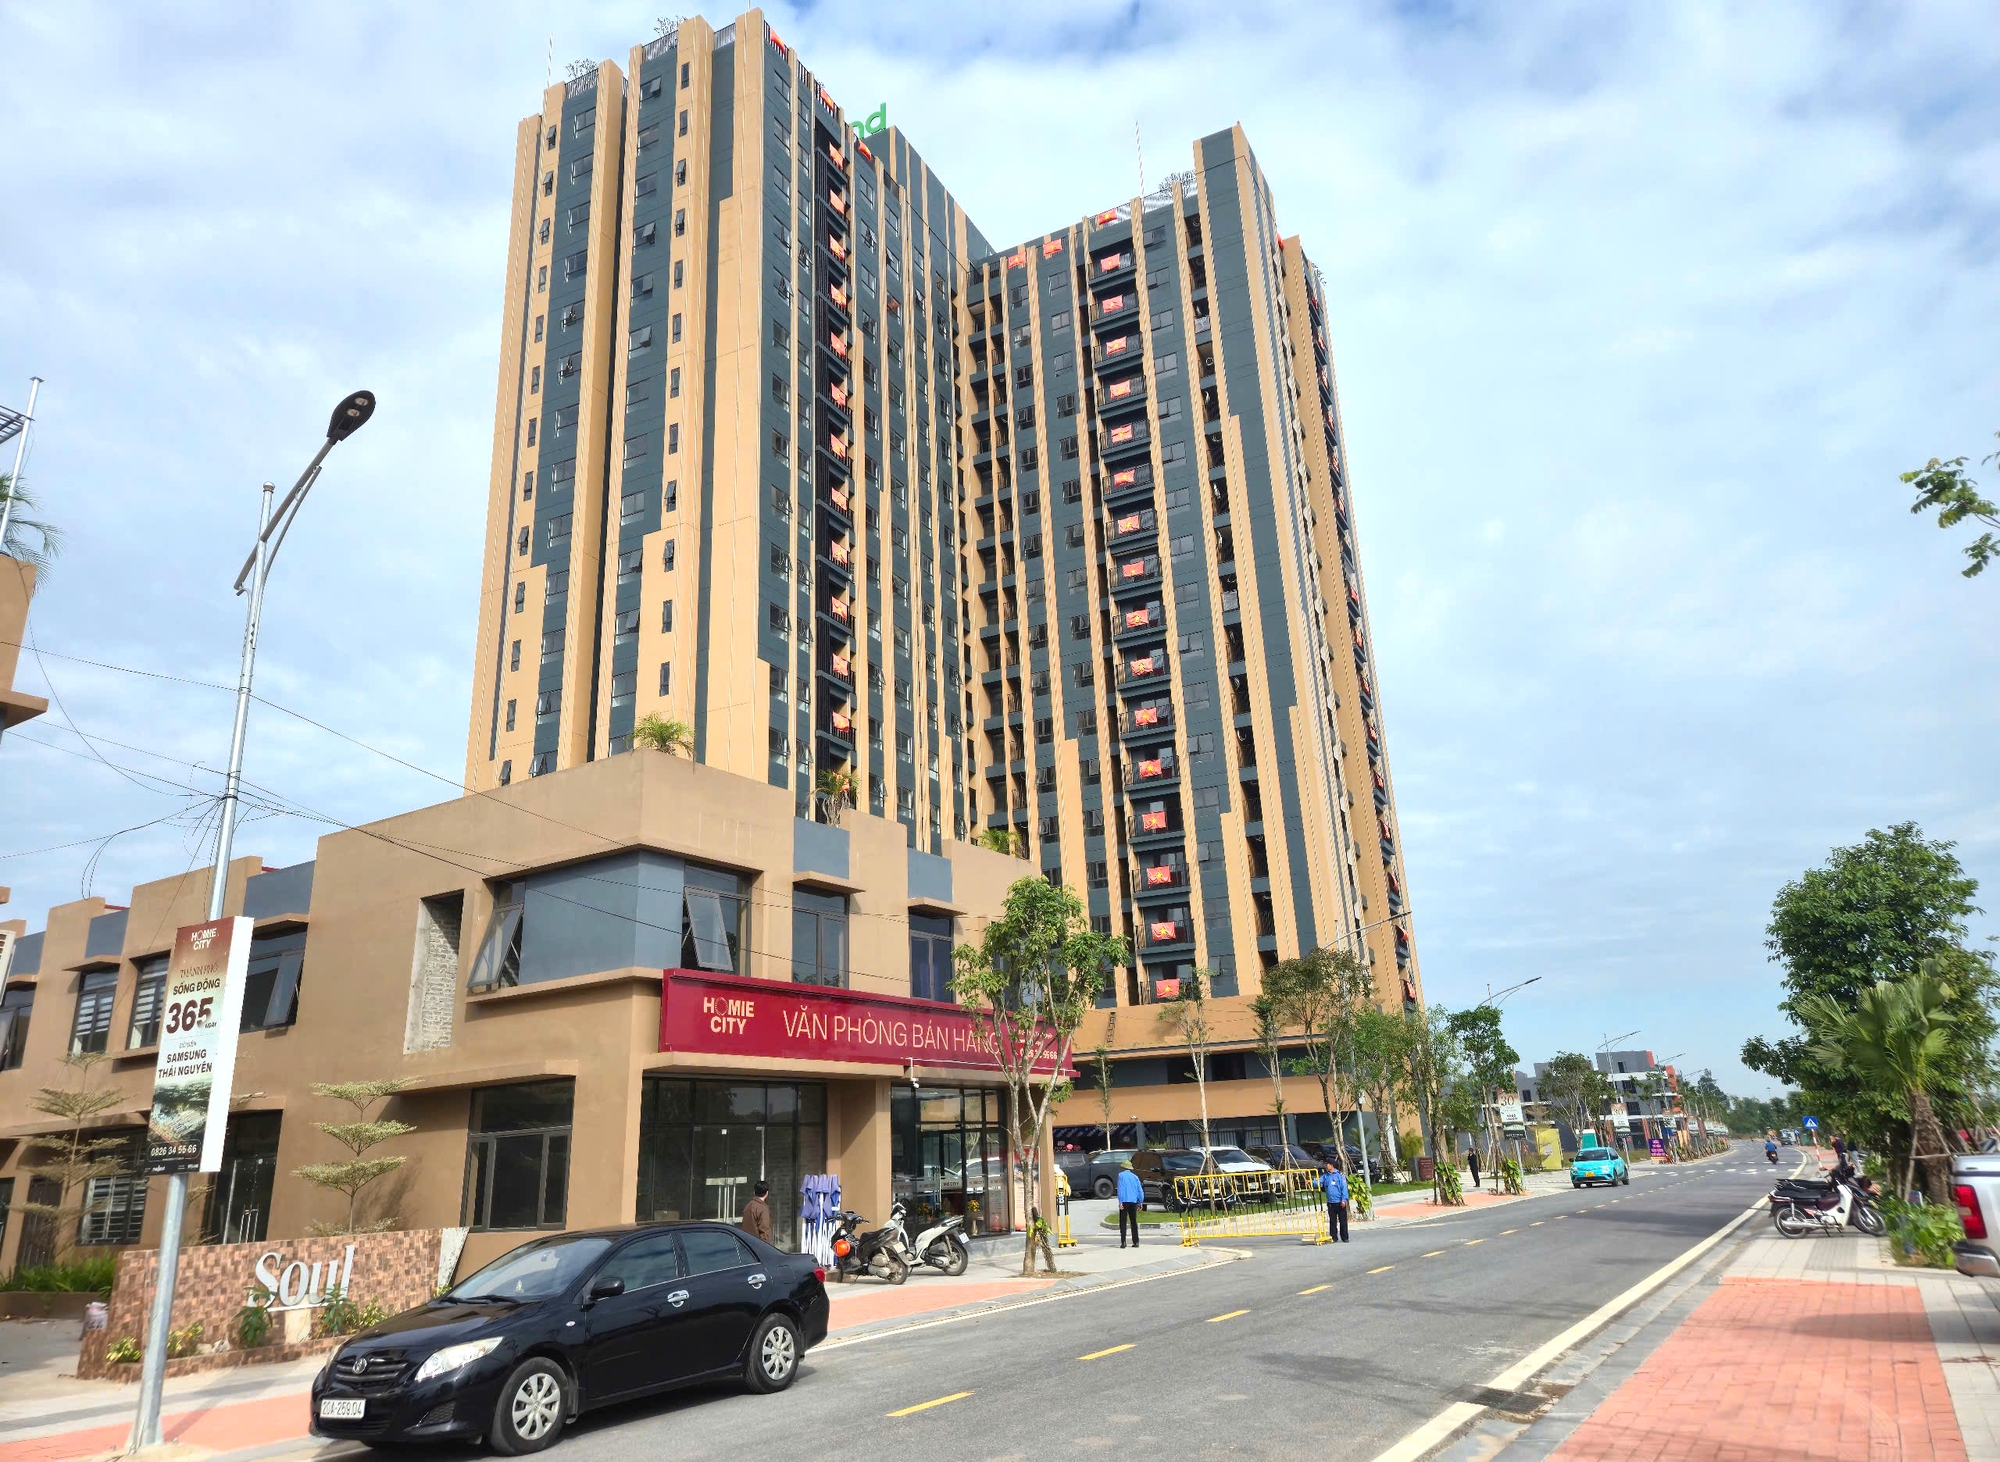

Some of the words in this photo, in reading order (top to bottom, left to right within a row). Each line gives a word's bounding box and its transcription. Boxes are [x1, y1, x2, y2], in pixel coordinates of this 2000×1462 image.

[194, 939, 212, 950] CITY
[196, 977, 221, 993] ĐỘNG
[166, 996, 214, 1034] 365
[703, 997, 755, 1018] HOMIE
[710, 1016, 747, 1035] CITY
[782, 1004, 828, 1041] VĂN
[834, 1011, 908, 1047] PHÒNG
[912, 1019, 949, 1051] BÁN
[953, 1023, 1001, 1054] HÀNG
[167, 1049, 206, 1063] SAMSUNG
[158, 1064, 176, 1078] THÁI
[178, 1061, 212, 1076] NGUYÊN
[1500, 1095, 1514, 1106] 30
[151, 1146, 167, 1157] 0826
[168, 1146, 177, 1155] 34
[178, 1145, 187, 1154] 55
[188, 1144, 197, 1153] 66
[247, 1245, 354, 1308] Soul
